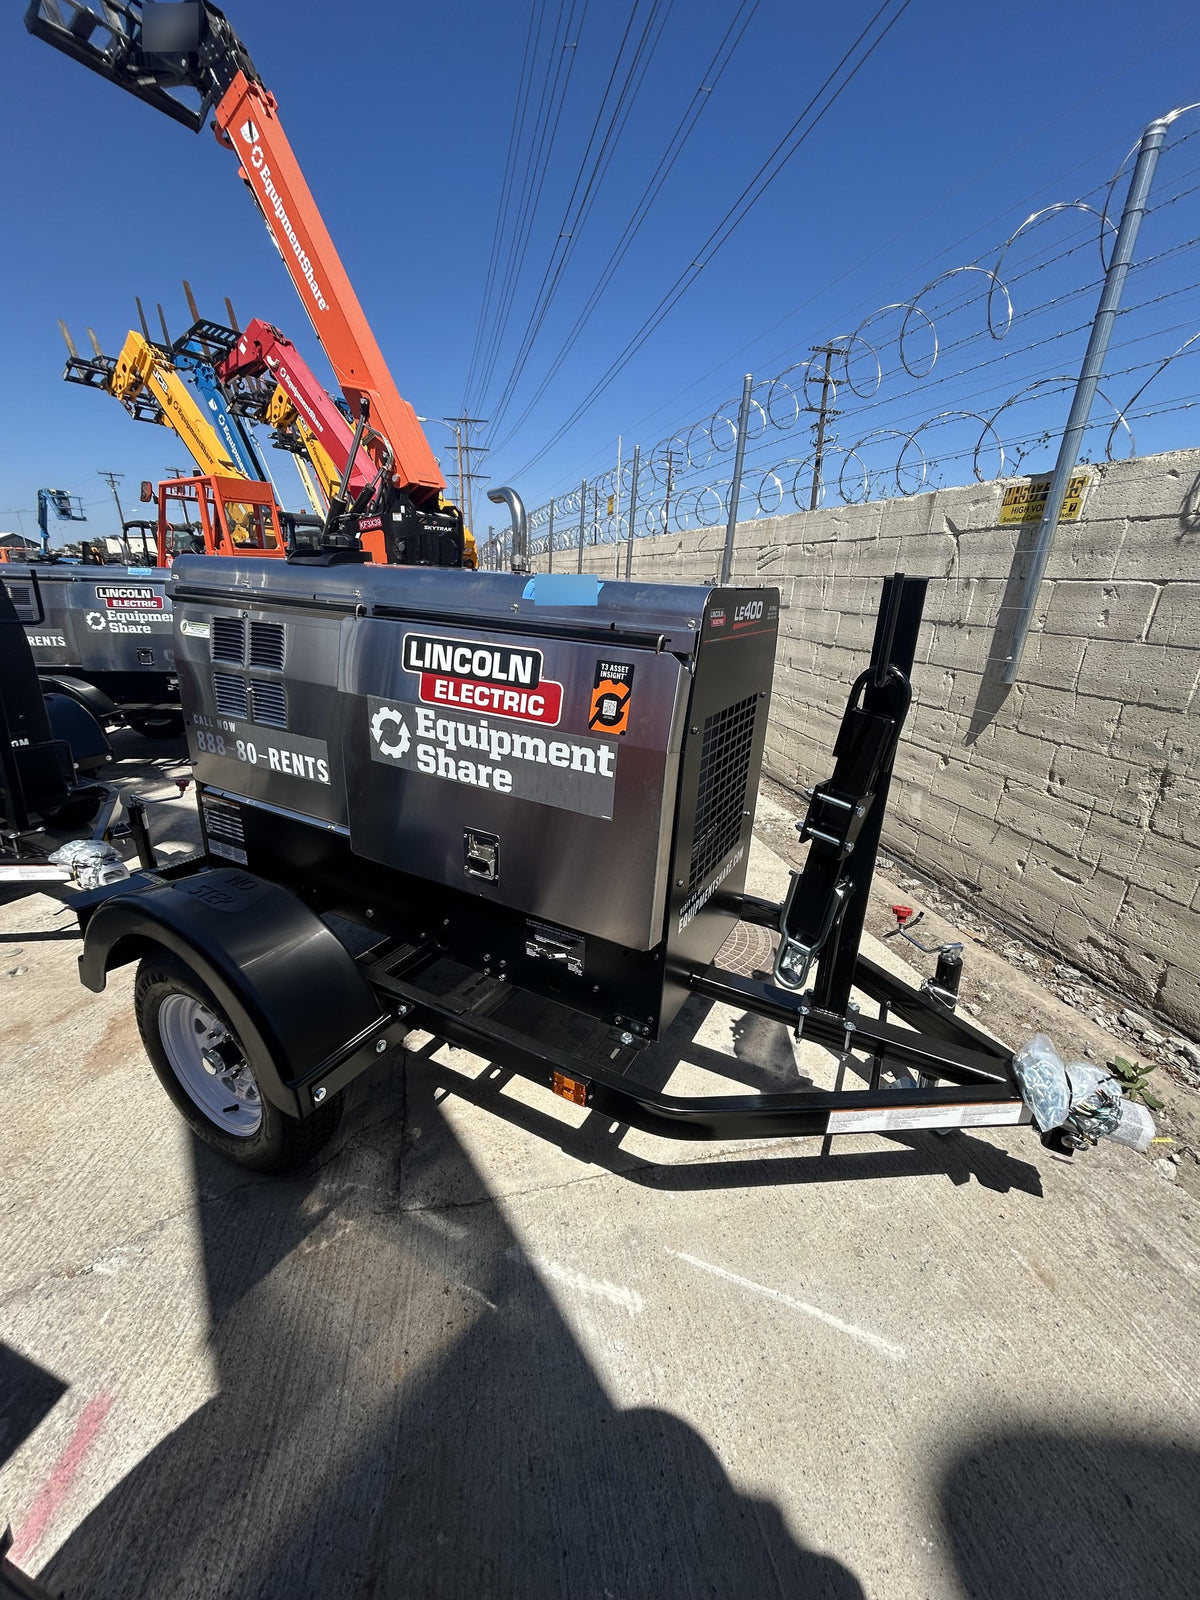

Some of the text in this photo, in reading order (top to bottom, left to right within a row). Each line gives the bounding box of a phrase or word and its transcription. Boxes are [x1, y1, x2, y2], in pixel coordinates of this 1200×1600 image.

[259, 163, 327, 311] EquipmentShare
[152, 370, 169, 393] JCB
[284, 374, 324, 432] EquipmentShare
[1010, 505, 1029, 514] HIGH
[99, 588, 151, 599] LINCOLN
[112, 600, 158, 608] ELECTRIC
[734, 601, 763, 621] LE400
[108, 622, 151, 634] Share
[409, 640, 533, 684] LINCOLN
[601, 663, 629, 674] T3 ASSET
[434, 679, 545, 716] ELECTRIC
[193, 714, 236, 733] CALL NOW
[415, 707, 615, 778] Equipment
[196, 730, 329, 782] 888-80-RENTS
[416, 743, 513, 793] Share
[225, 876, 258, 891] NO
[678, 846, 744, 934] EQUIPMENTSHARE.COM
[187, 885, 236, 905] STEP
